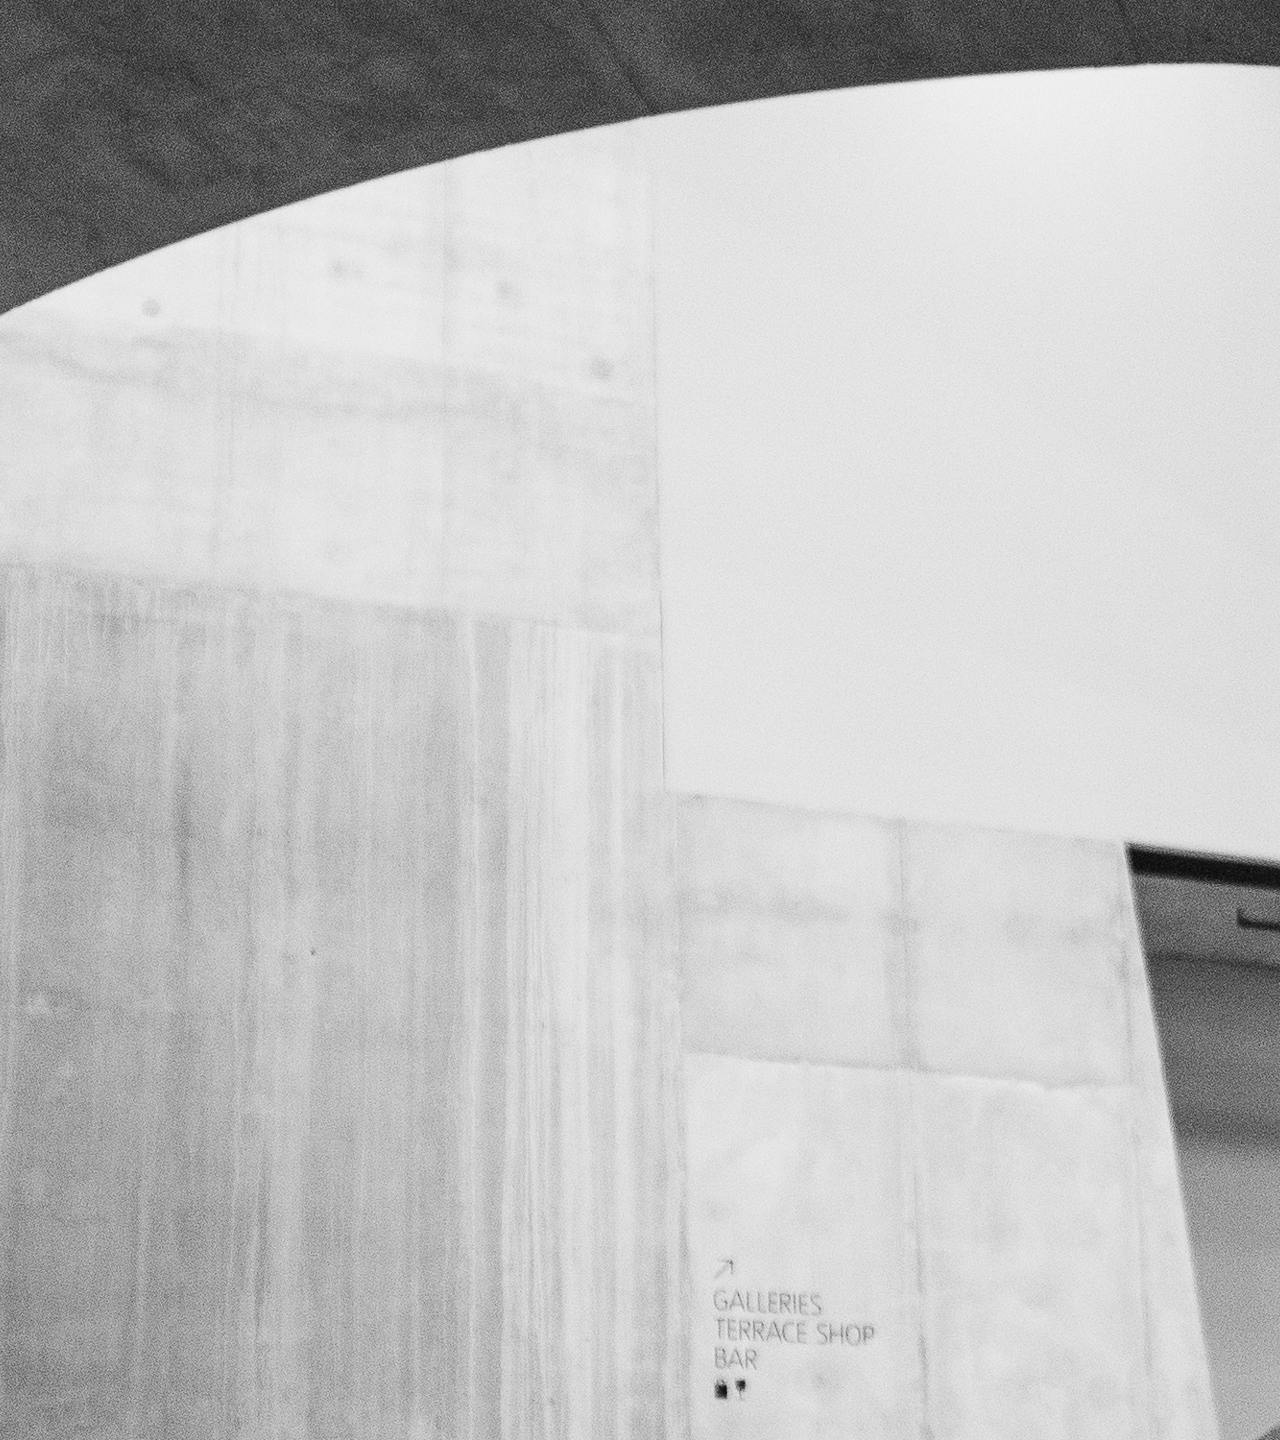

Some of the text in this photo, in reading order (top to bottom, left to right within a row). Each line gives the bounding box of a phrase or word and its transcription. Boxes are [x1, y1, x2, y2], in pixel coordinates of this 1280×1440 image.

[713, 1290, 823, 1316] GALLERIES
[716, 1318, 876, 1346] TERRACE SHOP
[714, 1346, 758, 1370] BAR
